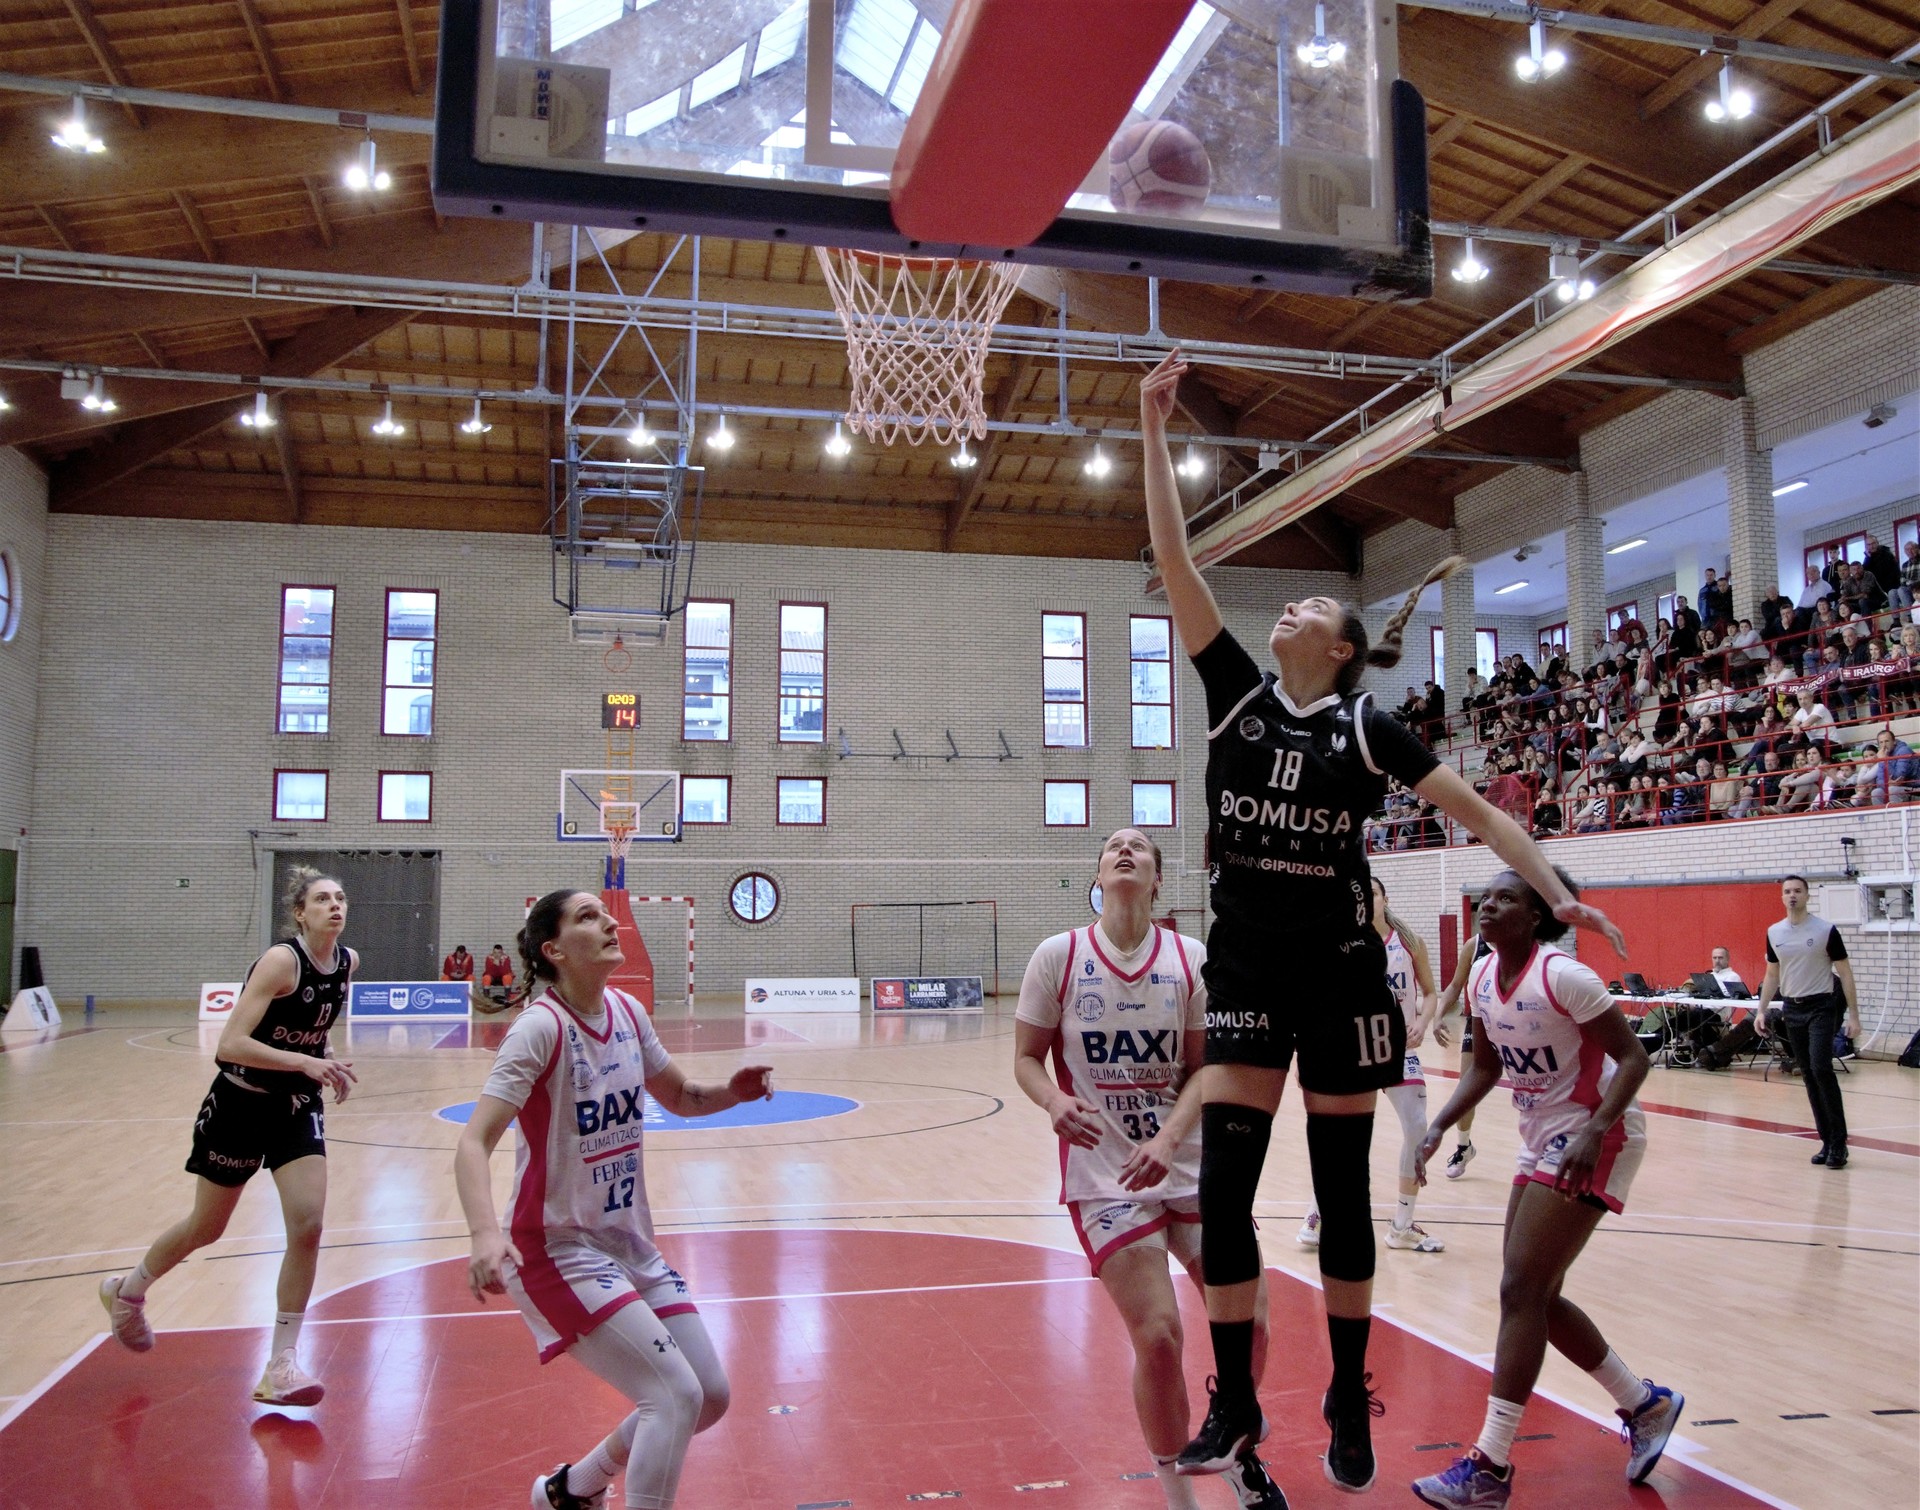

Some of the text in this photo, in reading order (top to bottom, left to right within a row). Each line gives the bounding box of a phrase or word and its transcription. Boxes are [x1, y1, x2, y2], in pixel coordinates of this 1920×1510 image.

[1853, 664, 1895, 677] IRAURGI
[615, 709, 636, 727] 14
[1267, 748, 1304, 791] 18
[1220, 789, 1352, 834] DOMUSA
[918, 983, 946, 991] MILAR
[313, 1003, 333, 1027] 13
[1080, 1029, 1178, 1064] BAXI
[1354, 1013, 1393, 1067] 18
[1498, 1044, 1559, 1075] AXI
[575, 1084, 643, 1136] BAX
[1122, 1111, 1161, 1141] 33
[604, 1176, 636, 1213] 12
